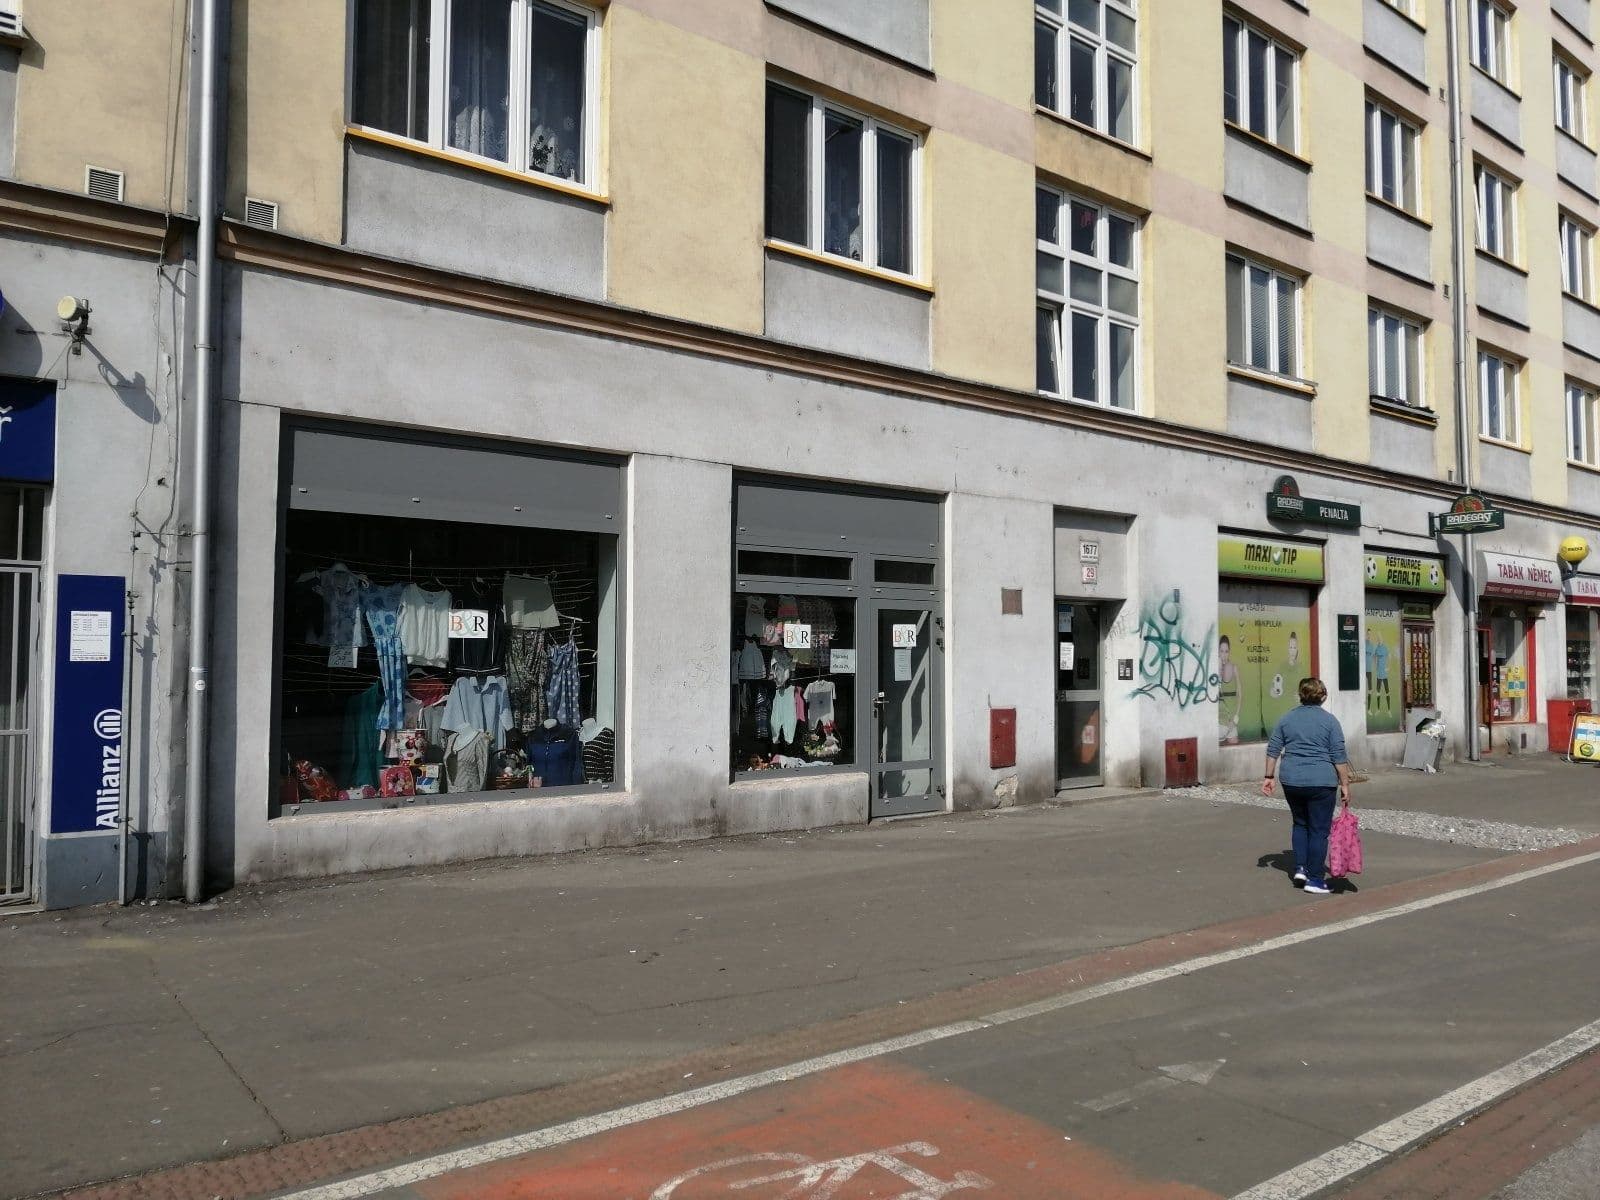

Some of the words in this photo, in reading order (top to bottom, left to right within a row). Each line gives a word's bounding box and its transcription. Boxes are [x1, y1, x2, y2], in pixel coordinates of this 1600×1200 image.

[1320, 506, 1349, 520] PENALTA
[1446, 512, 1493, 527] RADEGAST
[1083, 544, 1097, 556] 1677
[1244, 543, 1272, 563] MAXI
[1282, 547, 1297, 565] TIP
[1385, 556, 1421, 570] RESTAURACE
[1086, 567, 1095, 578] 29
[1387, 569, 1421, 587] PENALTA
[1497, 561, 1524, 581] TABÁK
[1527, 563, 1554, 584] NĚMEC
[95, 745, 121, 829] Allianz
